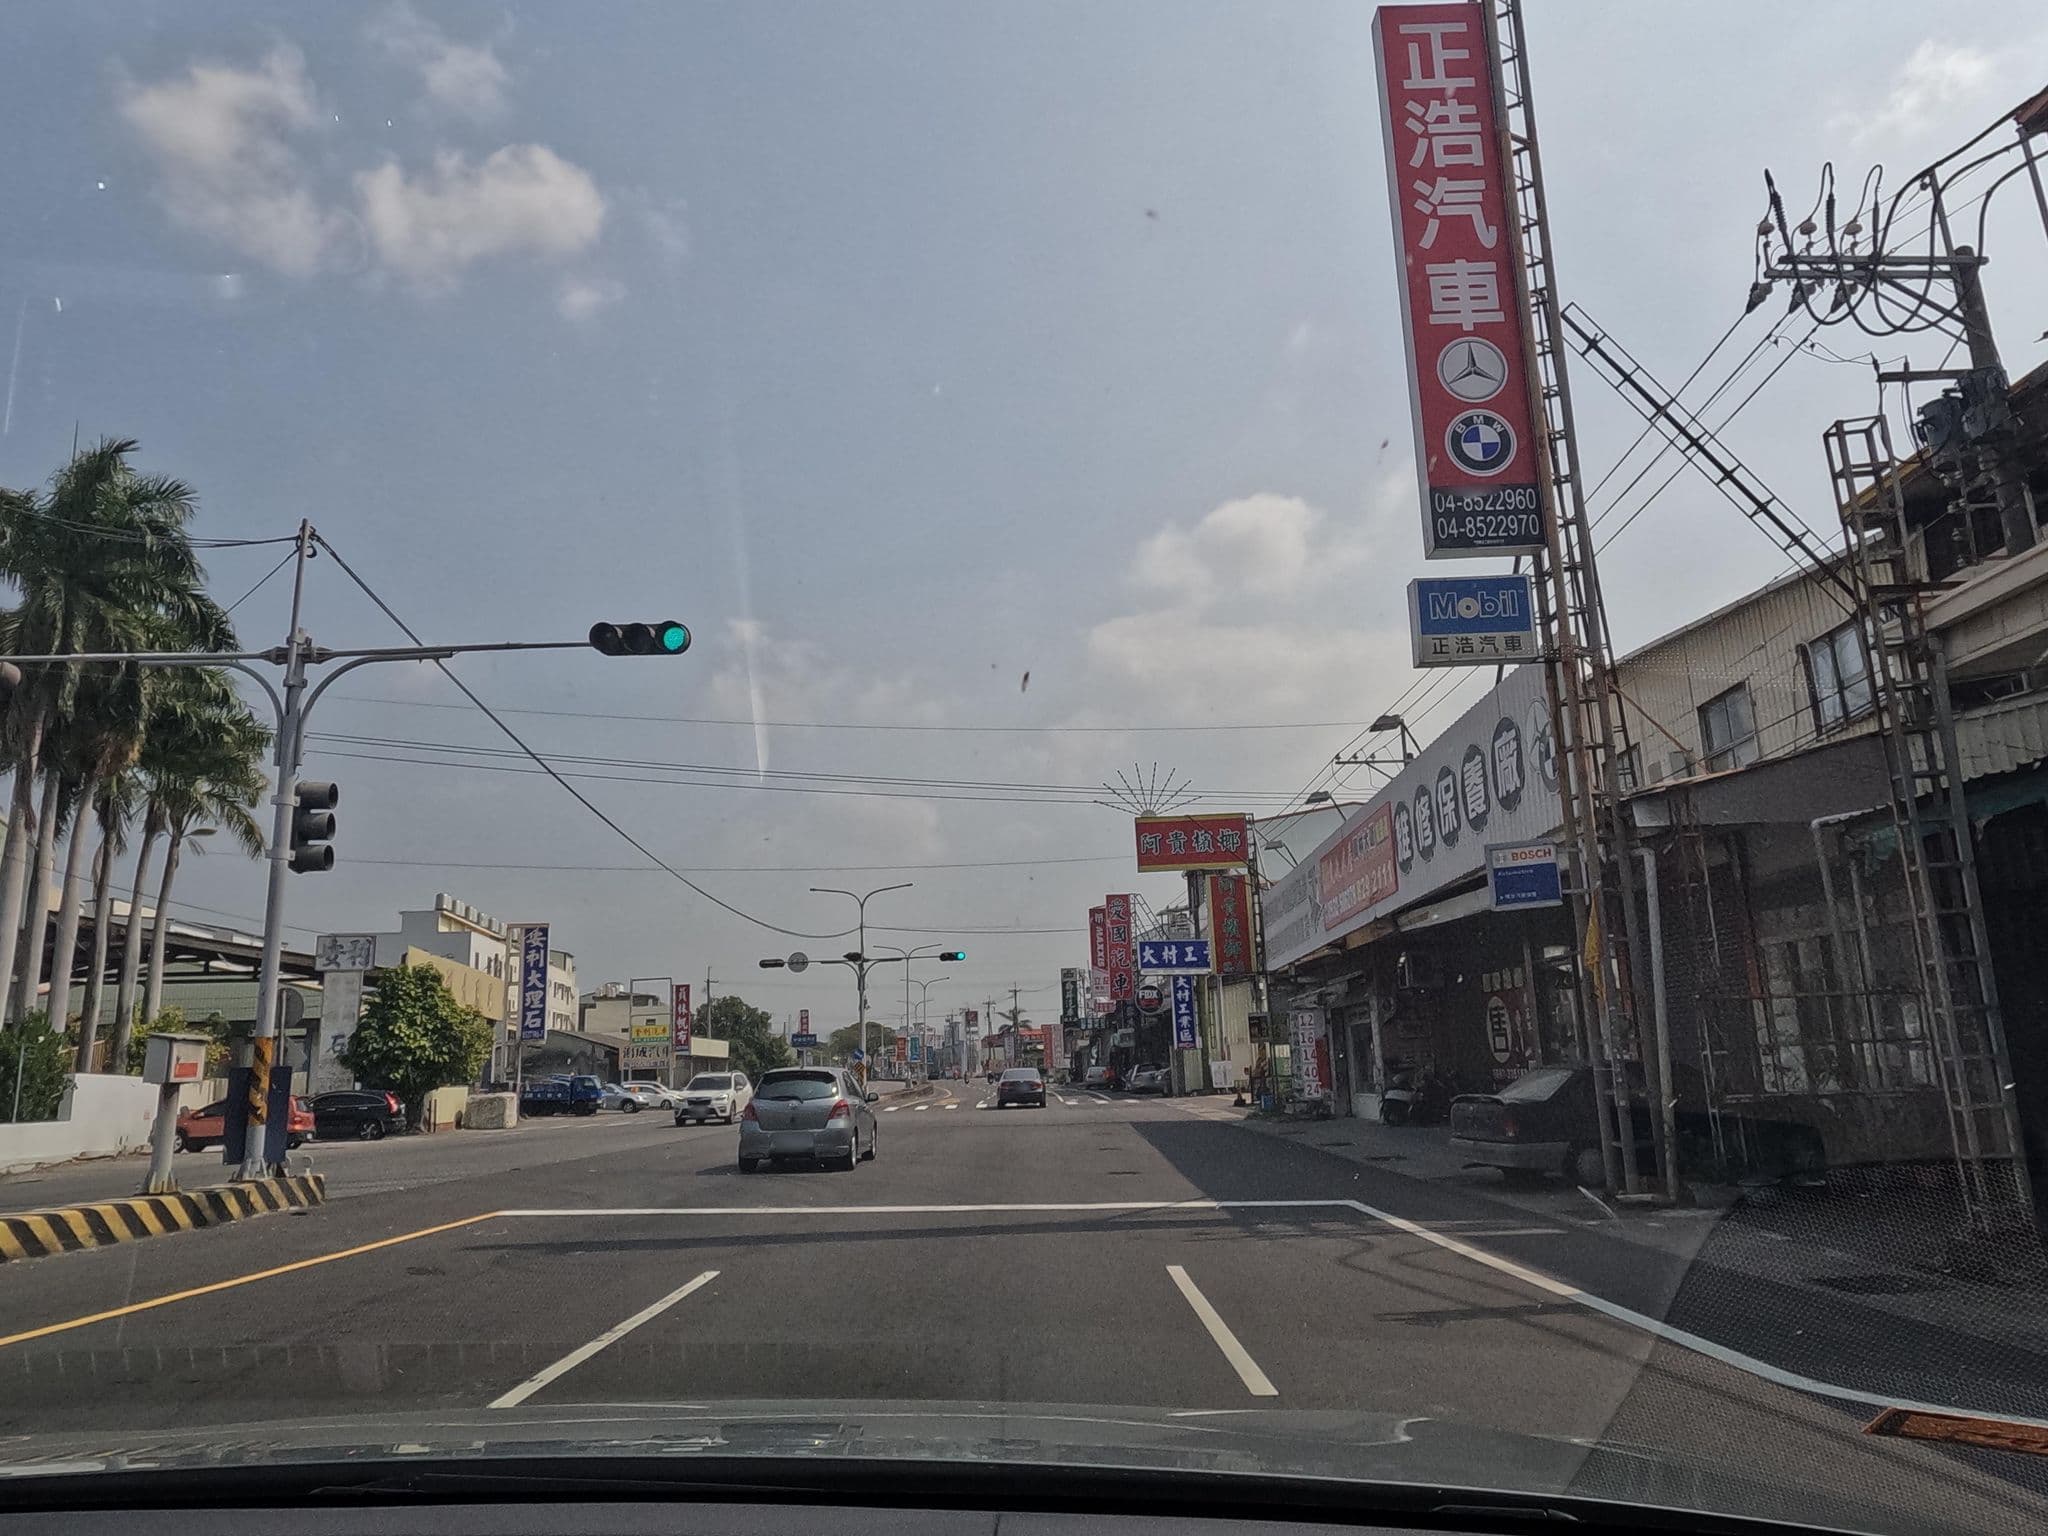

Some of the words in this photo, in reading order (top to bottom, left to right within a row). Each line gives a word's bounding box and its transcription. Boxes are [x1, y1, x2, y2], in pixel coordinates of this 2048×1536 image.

[1399, 22, 1506, 331] 正浩汽車
[1455, 415, 1505, 434] BMW
[1435, 488, 1537, 513] 04-8522960
[1437, 514, 1539, 539] 04-8522970
[1429, 589, 1519, 620] Mobil
[1431, 635, 1523, 655] 正浩汽車
[1395, 728, 1522, 868] 維修保養廠
[1140, 828, 1241, 856] 阿貴檳榔
[1511, 847, 1552, 861] BOSCH
[1108, 897, 1130, 998] 愛國汽車
[524, 927, 547, 1029] 安利大理石
[1175, 976, 1194, 1042] 大村工業區
